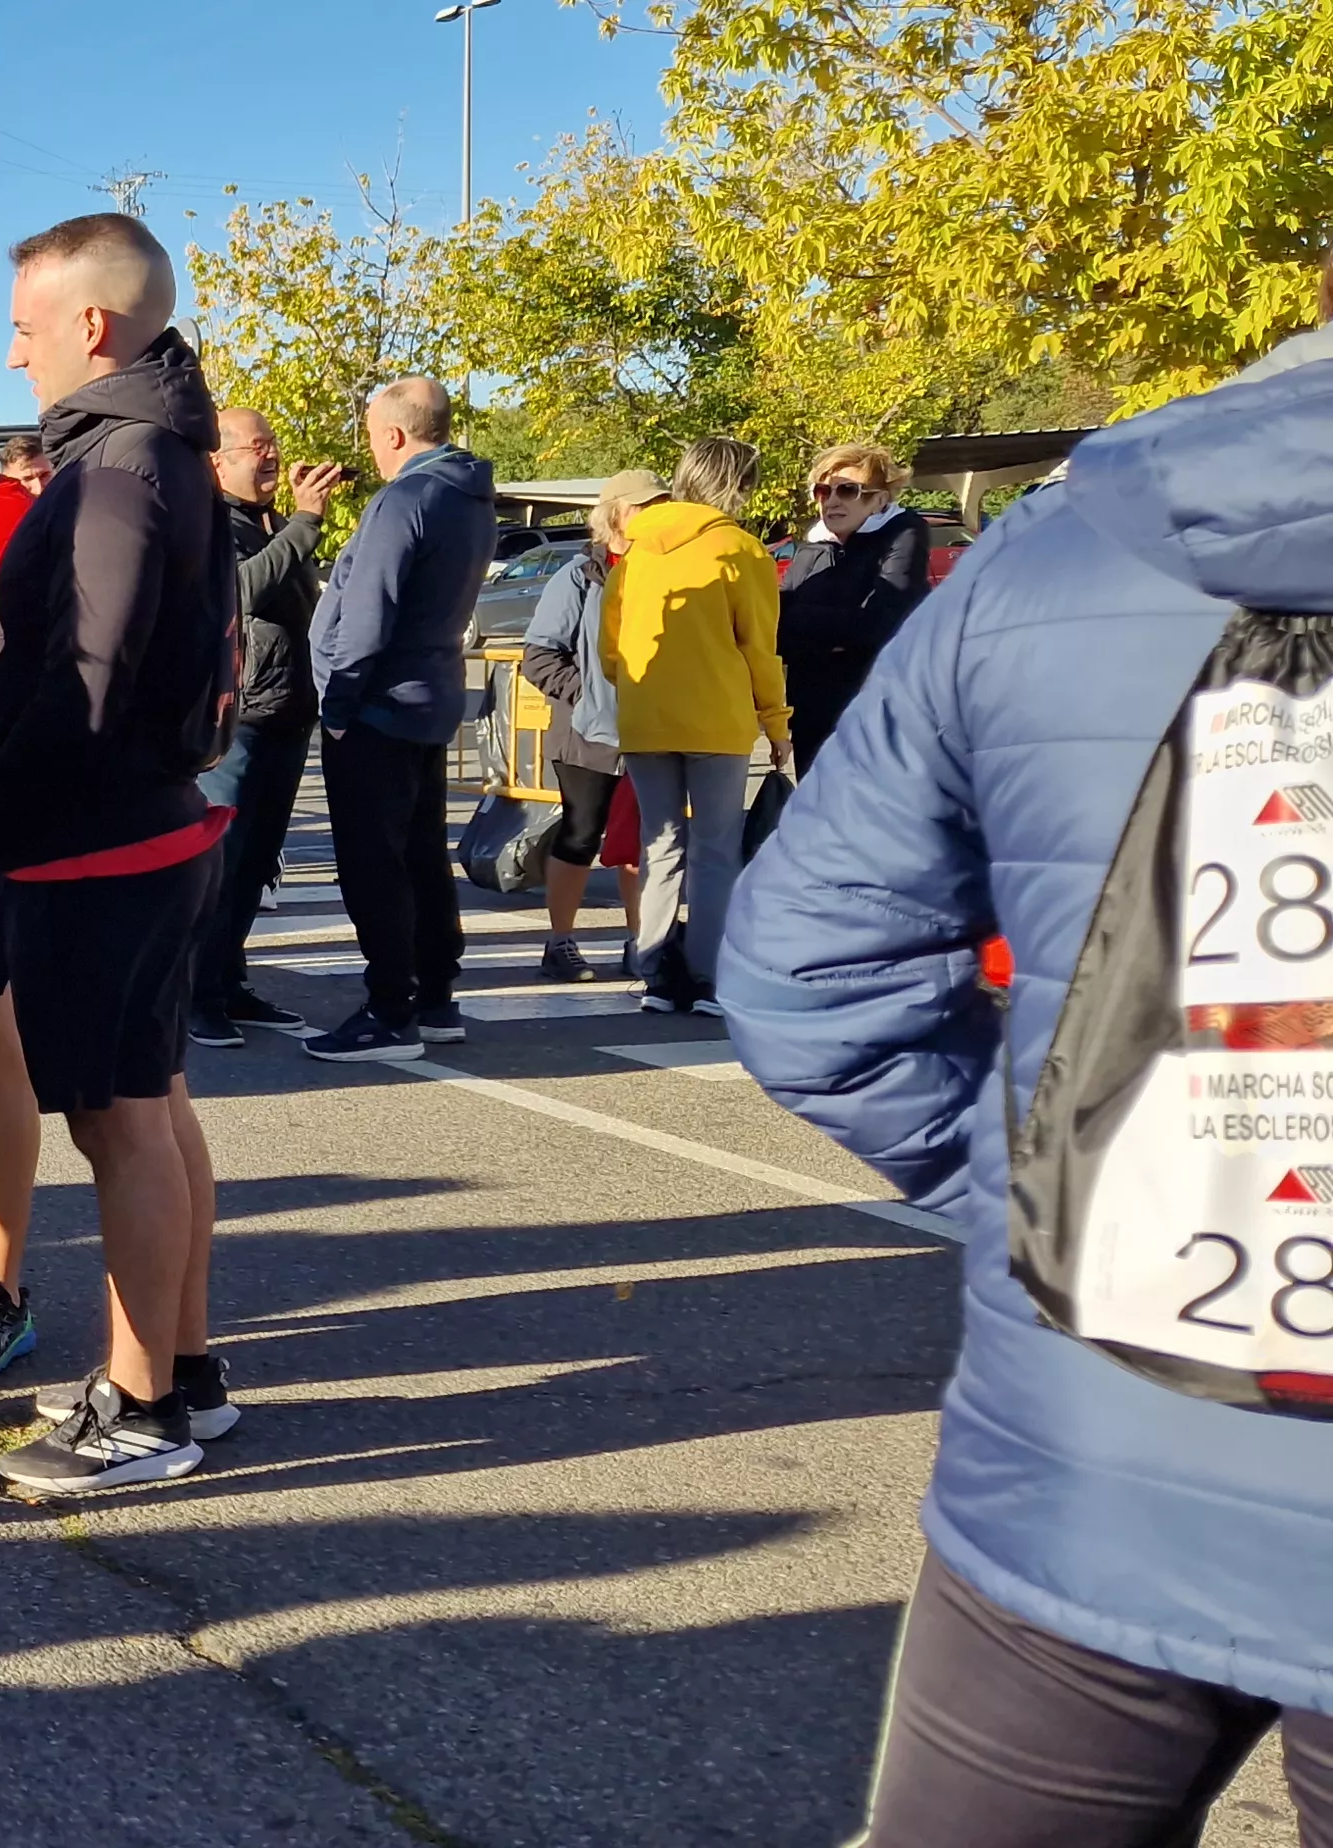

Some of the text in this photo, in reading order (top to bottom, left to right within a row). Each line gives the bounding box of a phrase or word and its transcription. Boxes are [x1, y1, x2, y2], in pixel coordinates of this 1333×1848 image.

[1208, 1072, 1306, 1100] MARCHA
[1190, 1112, 1333, 1142] LA ESCLERO
[1175, 1230, 1333, 1341] 28
